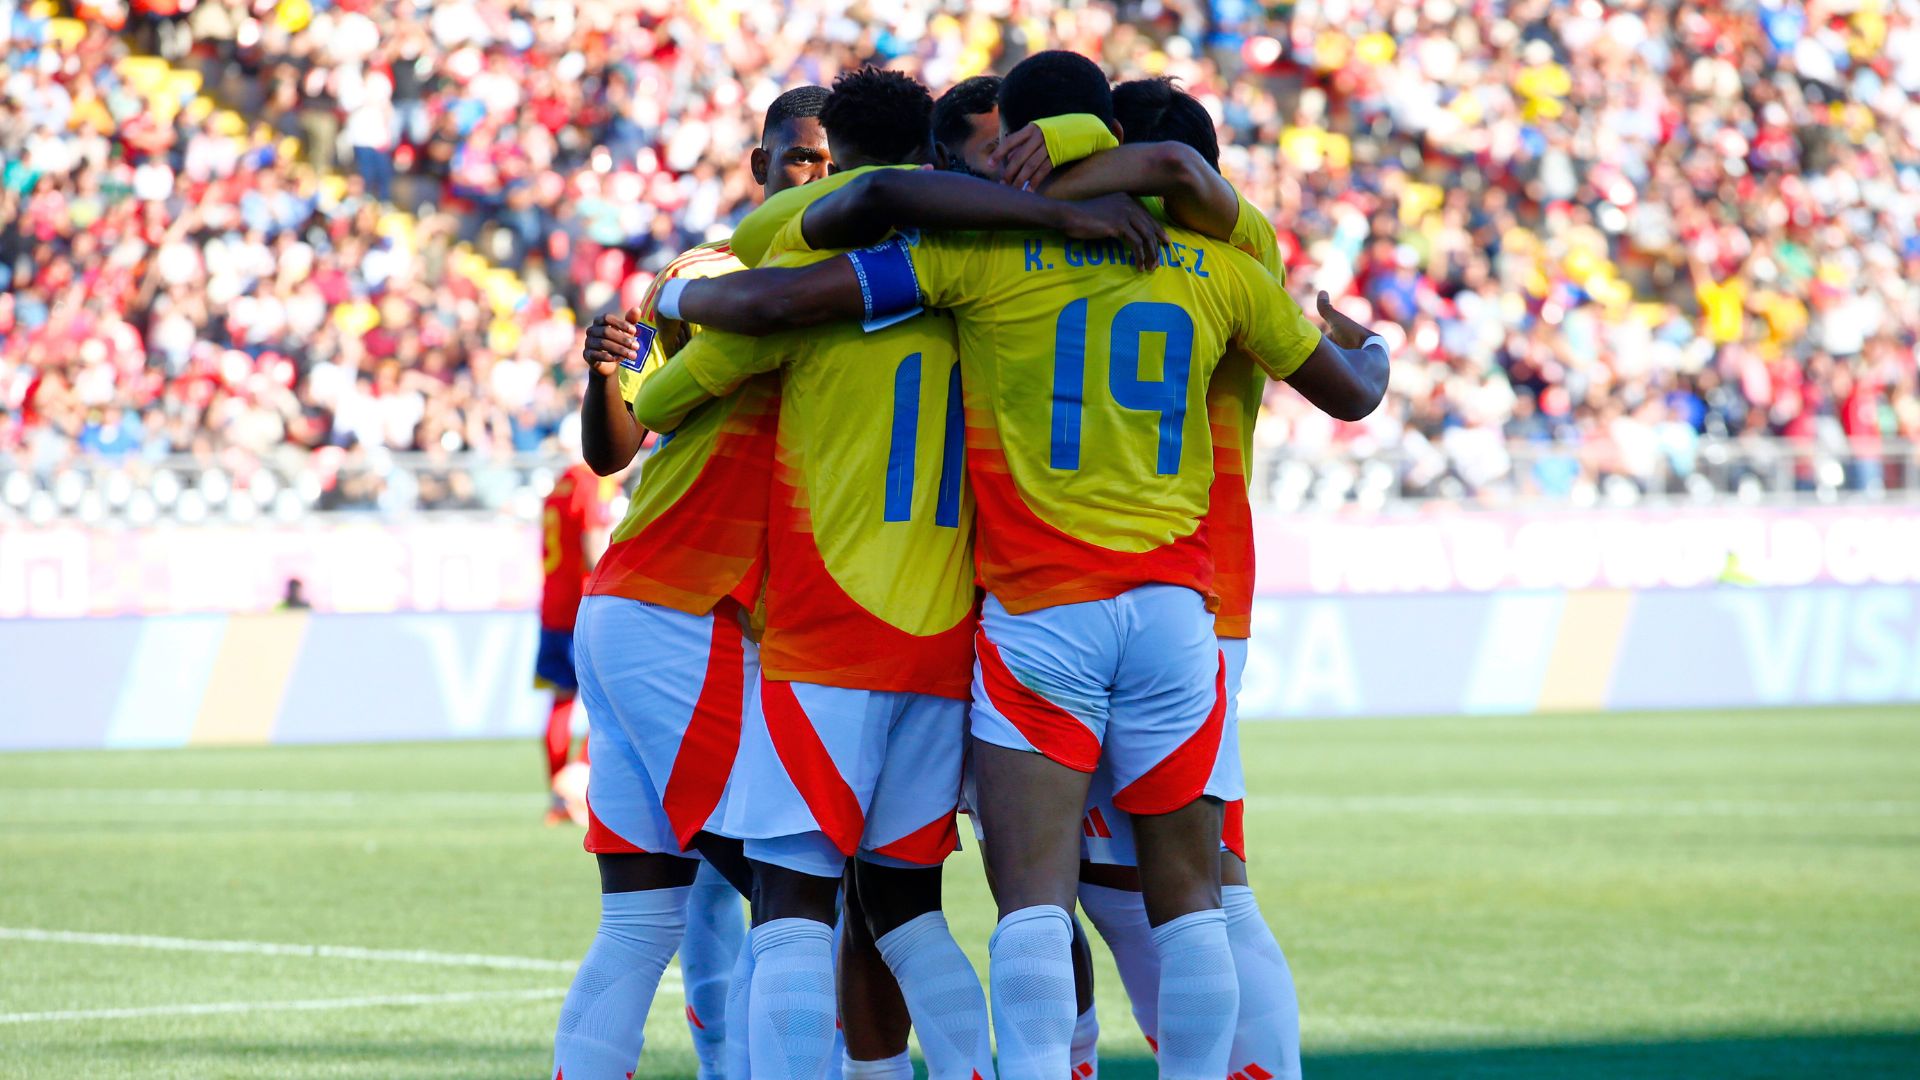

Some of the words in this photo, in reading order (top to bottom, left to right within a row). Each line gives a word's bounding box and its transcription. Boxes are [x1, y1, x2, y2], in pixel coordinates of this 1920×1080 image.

[1064, 239, 1209, 278] GONLEZ
[884, 352, 965, 528] 11
[1050, 297, 1194, 474] 19
[1716, 592, 1920, 694] VIS
